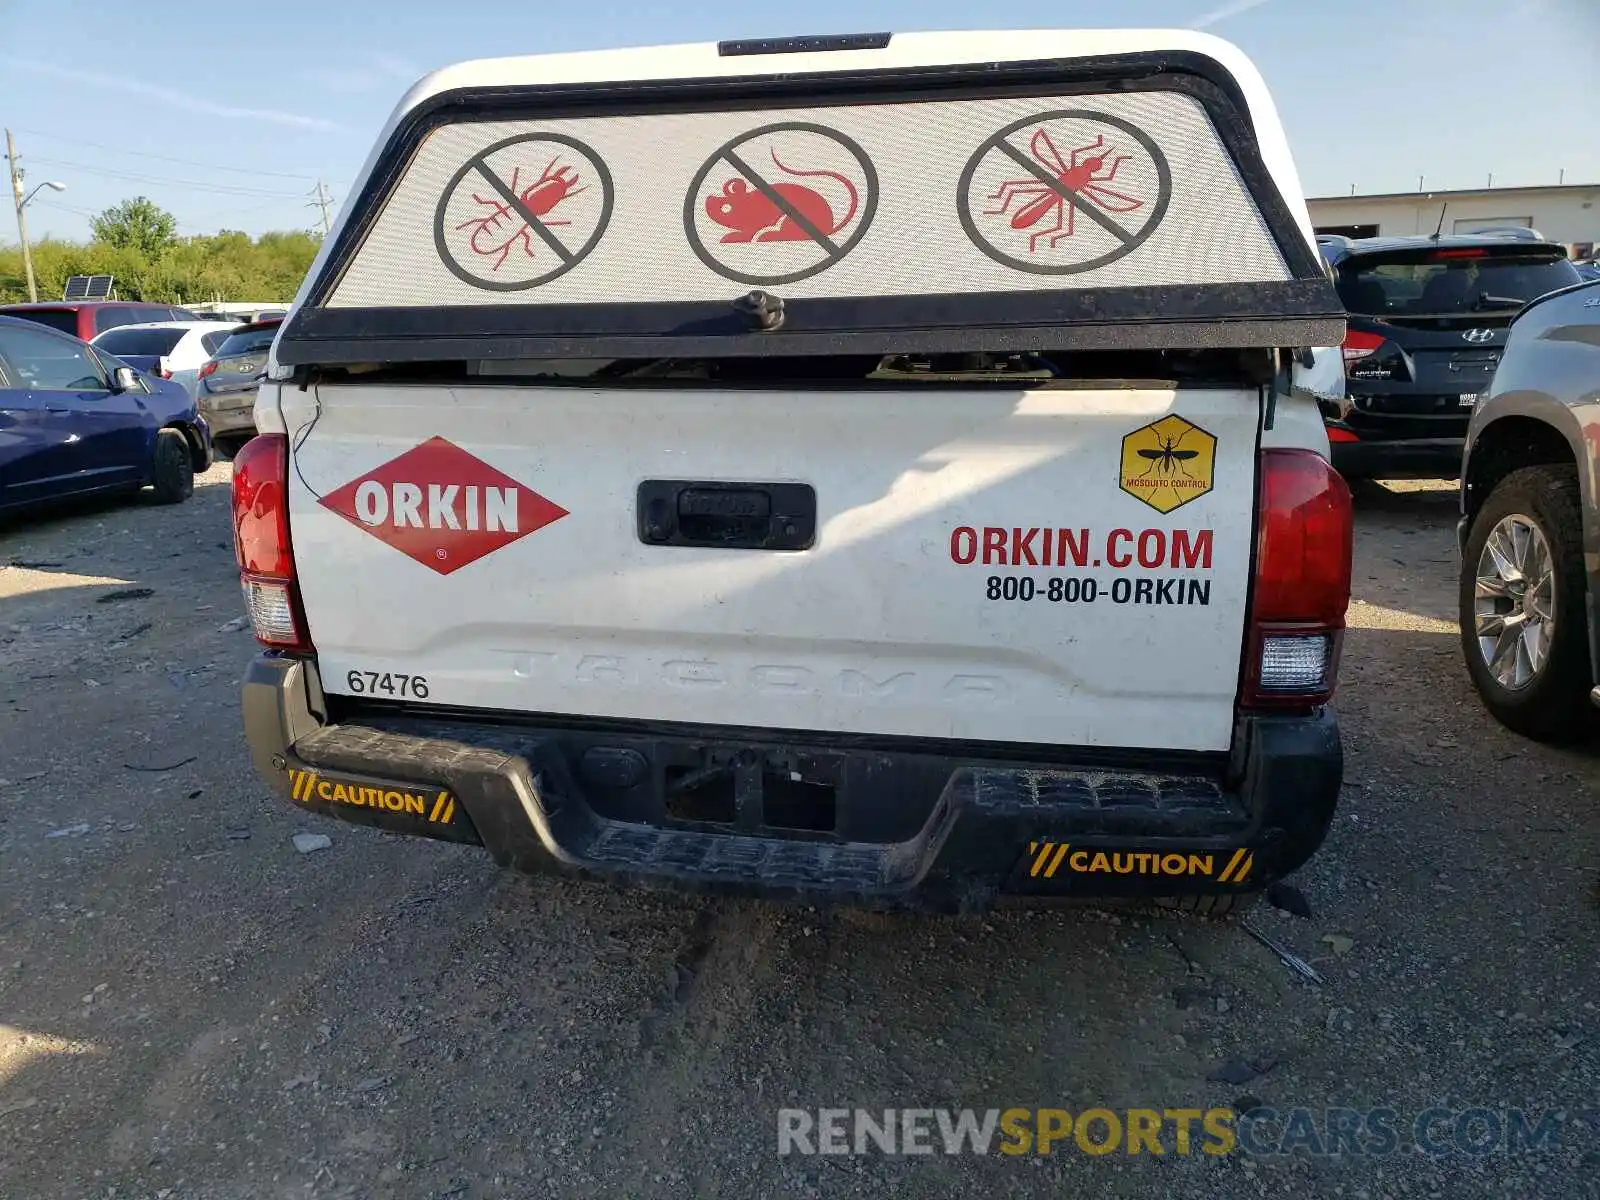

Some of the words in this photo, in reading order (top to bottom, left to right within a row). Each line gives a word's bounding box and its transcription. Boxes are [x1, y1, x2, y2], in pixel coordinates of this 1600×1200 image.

[1126, 479, 1169, 488] MOSQUITO
[1171, 479, 1207, 489] CONTROL
[354, 480, 519, 533] ORKIN
[950, 526, 1214, 569] ORKIN.COM
[986, 576, 1211, 605] 800-800-ORKIN
[347, 670, 429, 699] 67476
[488, 648, 1014, 705] TACOMA
[317, 781, 425, 814] CAUTION
[1069, 851, 1213, 875] CAUTION
